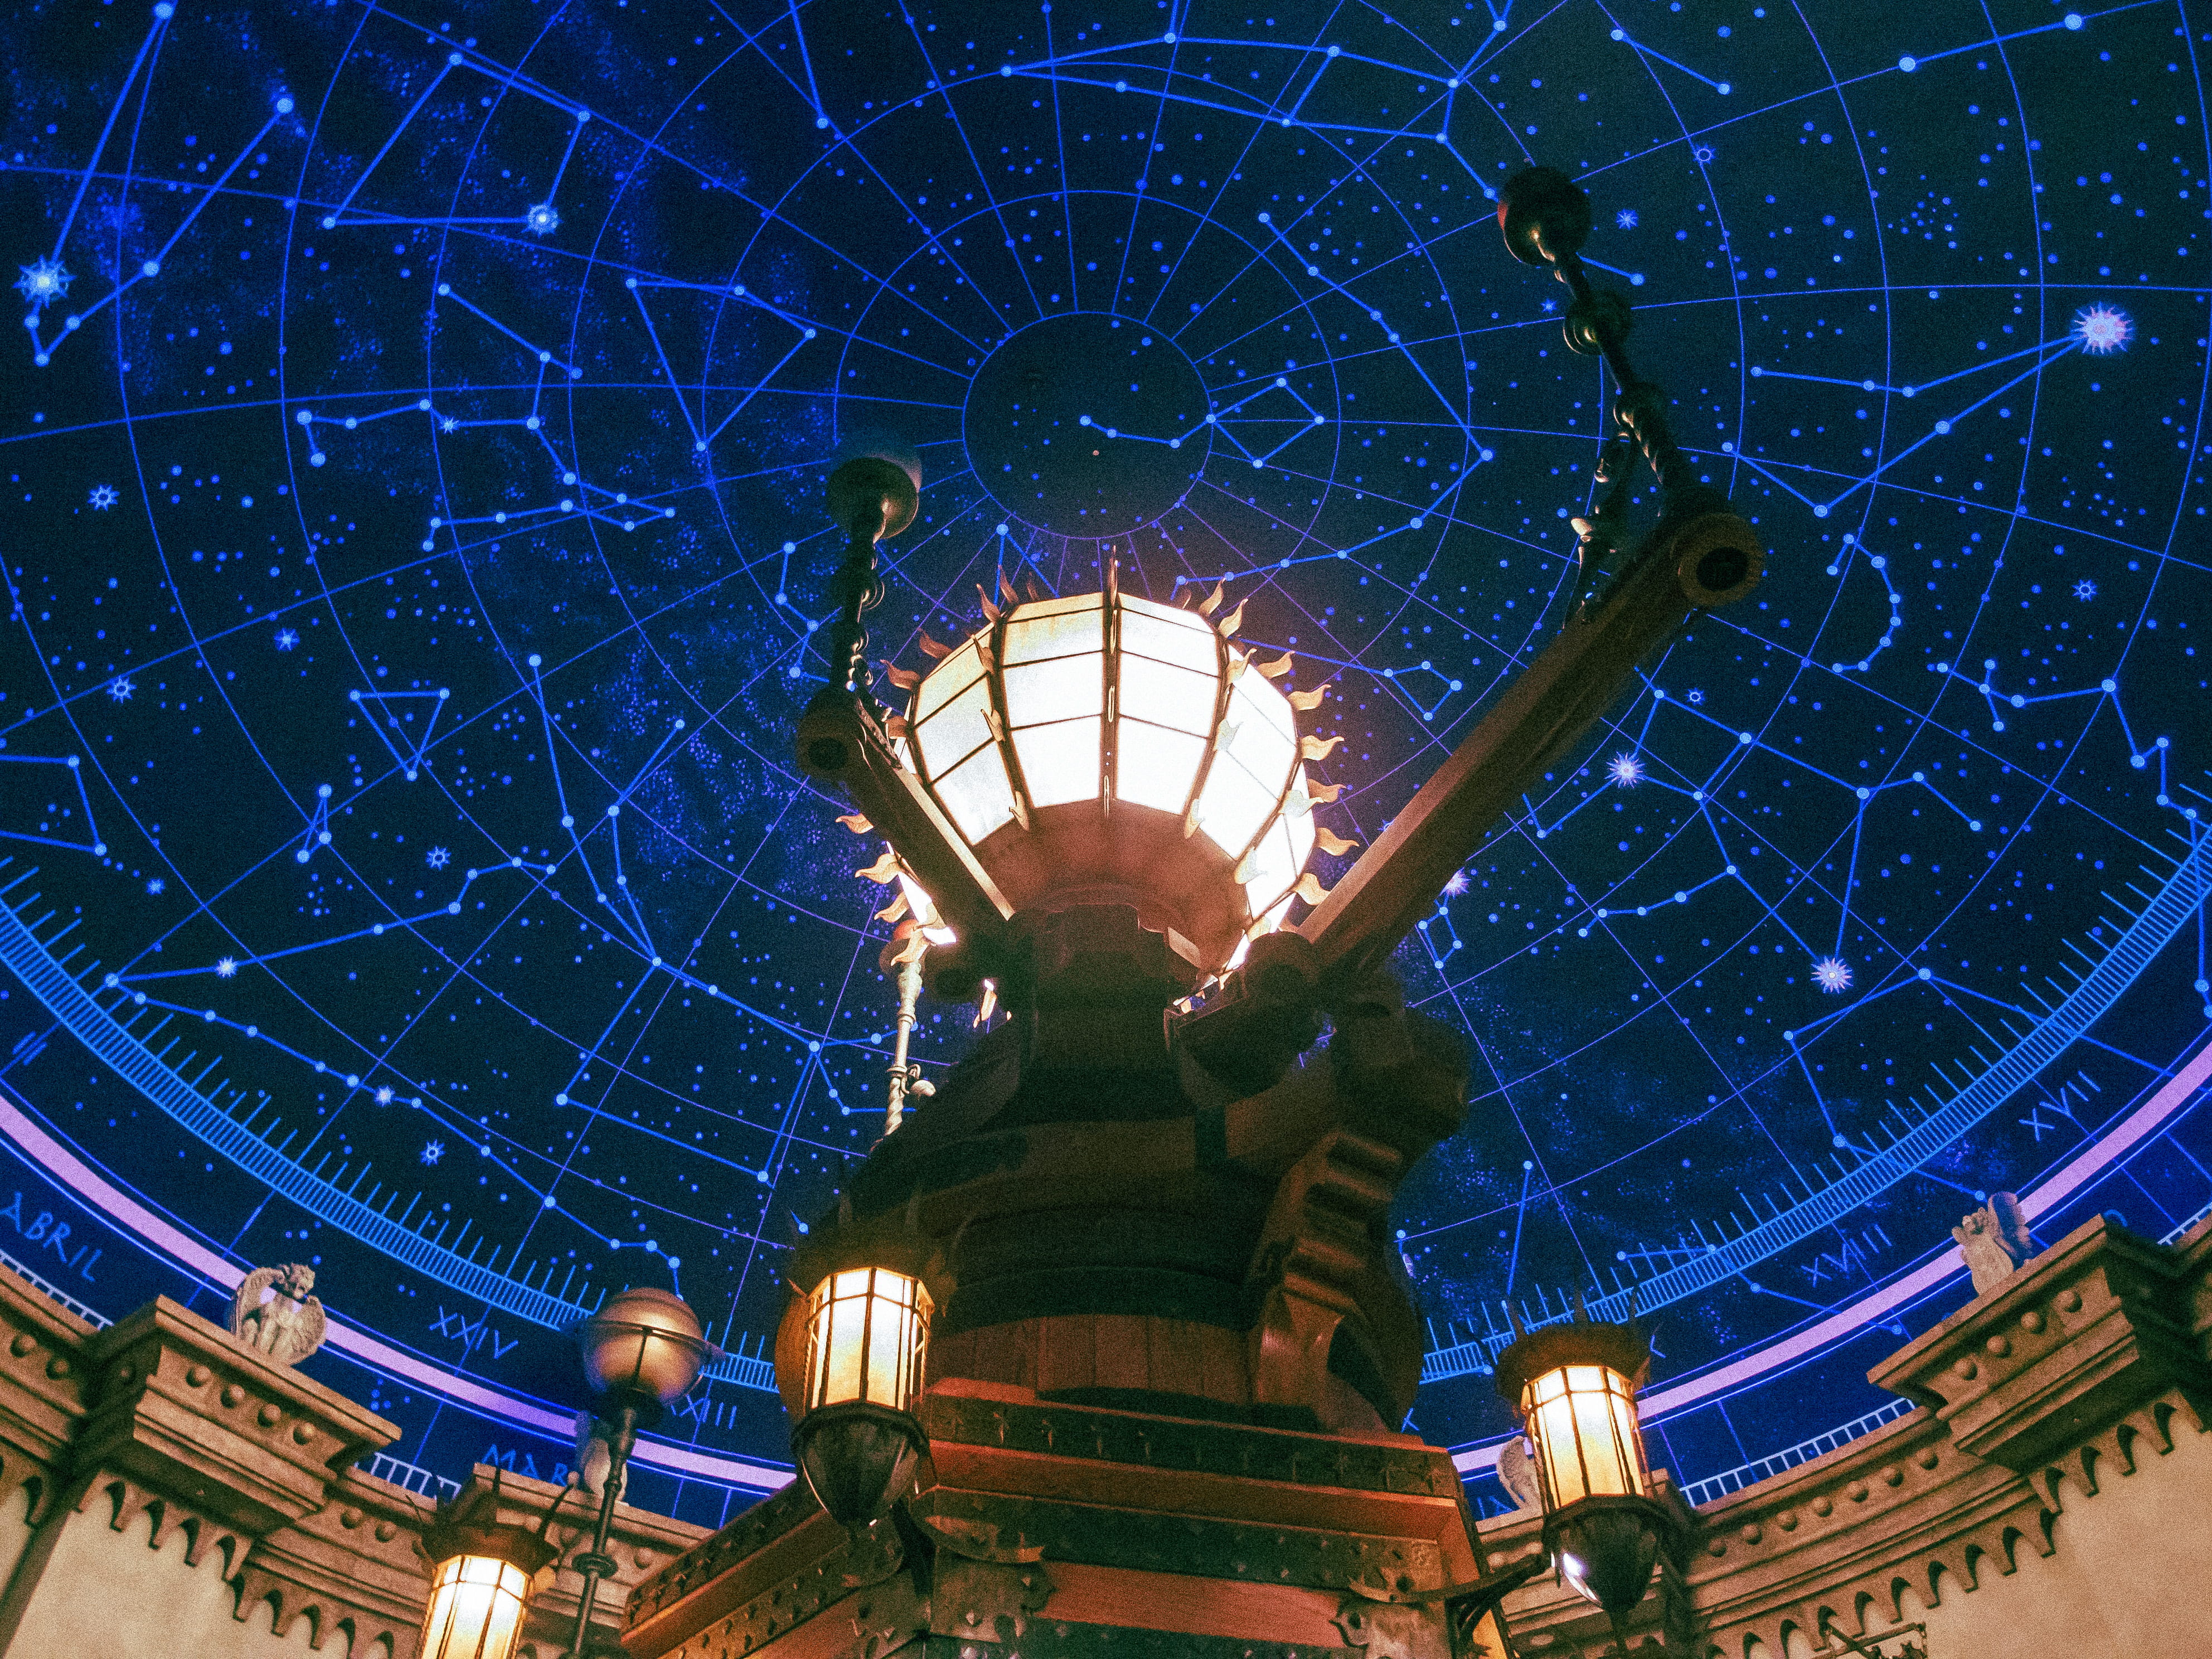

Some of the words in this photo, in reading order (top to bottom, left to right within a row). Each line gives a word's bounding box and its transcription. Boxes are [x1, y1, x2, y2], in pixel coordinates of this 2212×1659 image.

[2019, 1070, 2101, 1142] XVII
[0, 1191, 102, 1282] ABRIL
[1801, 1223, 1892, 1288] XVIII
[429, 1305, 519, 1359] XXIV
[671, 1394, 737, 1430] XIII
